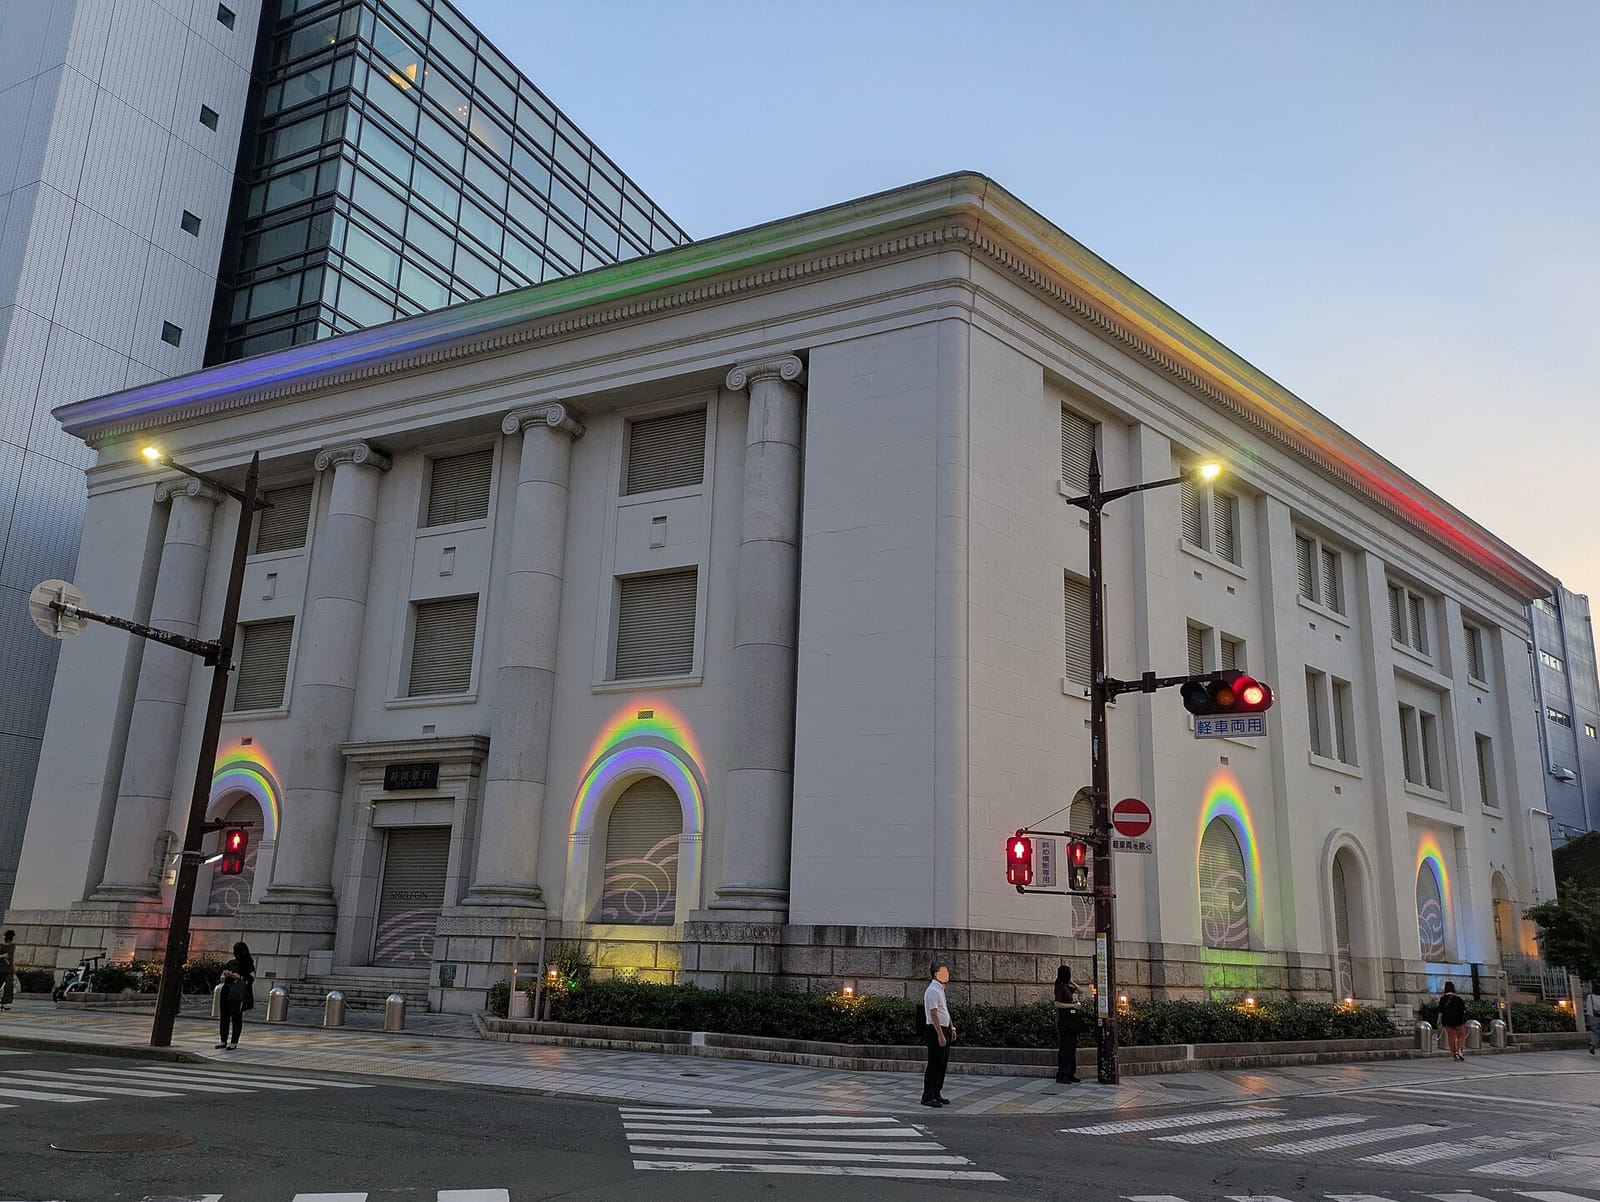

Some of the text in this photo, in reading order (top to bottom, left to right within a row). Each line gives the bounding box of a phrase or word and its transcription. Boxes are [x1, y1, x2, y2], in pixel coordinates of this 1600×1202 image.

[1197, 719, 1262, 735] 軽車両用
[1112, 840, 1152, 854] 軽車両を除く
